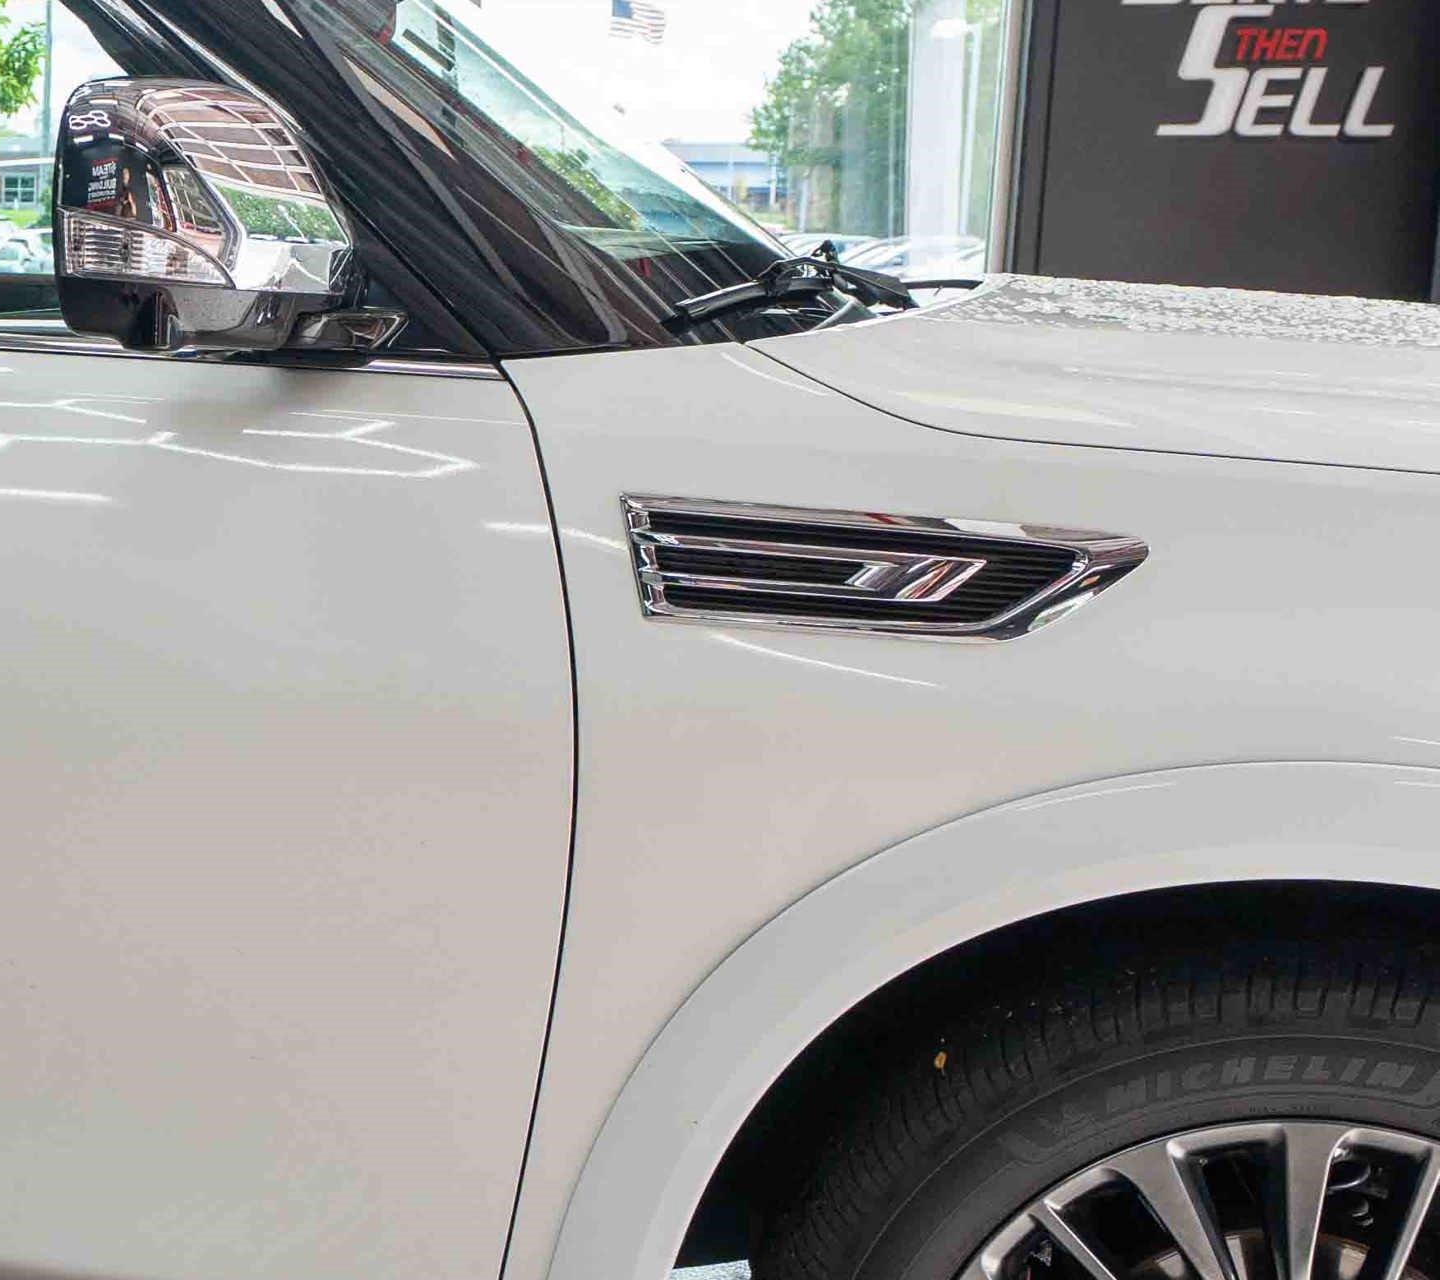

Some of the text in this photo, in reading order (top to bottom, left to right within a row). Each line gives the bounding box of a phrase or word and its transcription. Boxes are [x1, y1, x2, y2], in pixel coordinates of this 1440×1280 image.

[1155, 4, 1395, 137] SELL
[1235, 26, 1329, 61] THEN
[1105, 1055, 1416, 1113] MICHELIN
